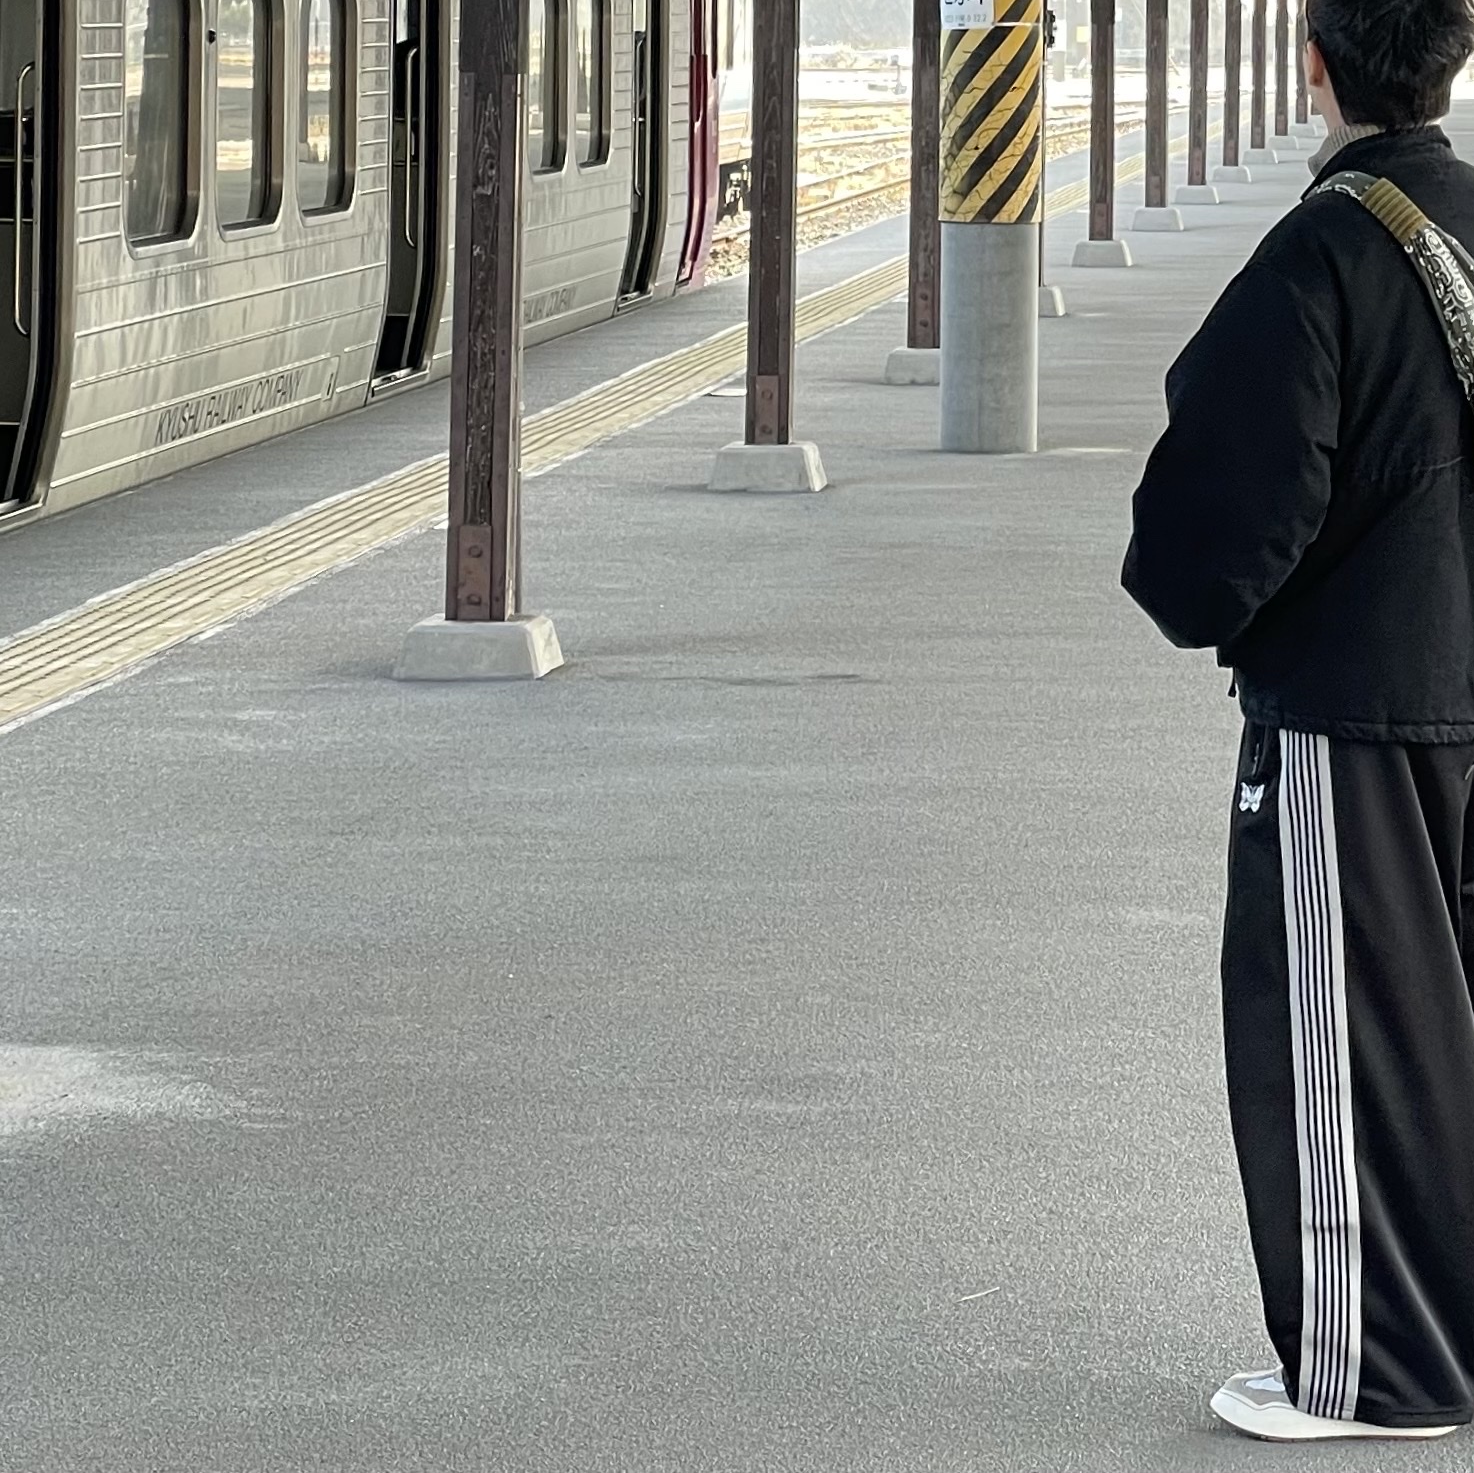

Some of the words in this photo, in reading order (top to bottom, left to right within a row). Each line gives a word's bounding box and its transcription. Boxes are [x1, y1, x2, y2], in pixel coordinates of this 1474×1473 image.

[154, 400, 204, 446] KYUSHU
[203, 384, 253, 429] RAILWAY
[251, 370, 304, 414] COMPANY
